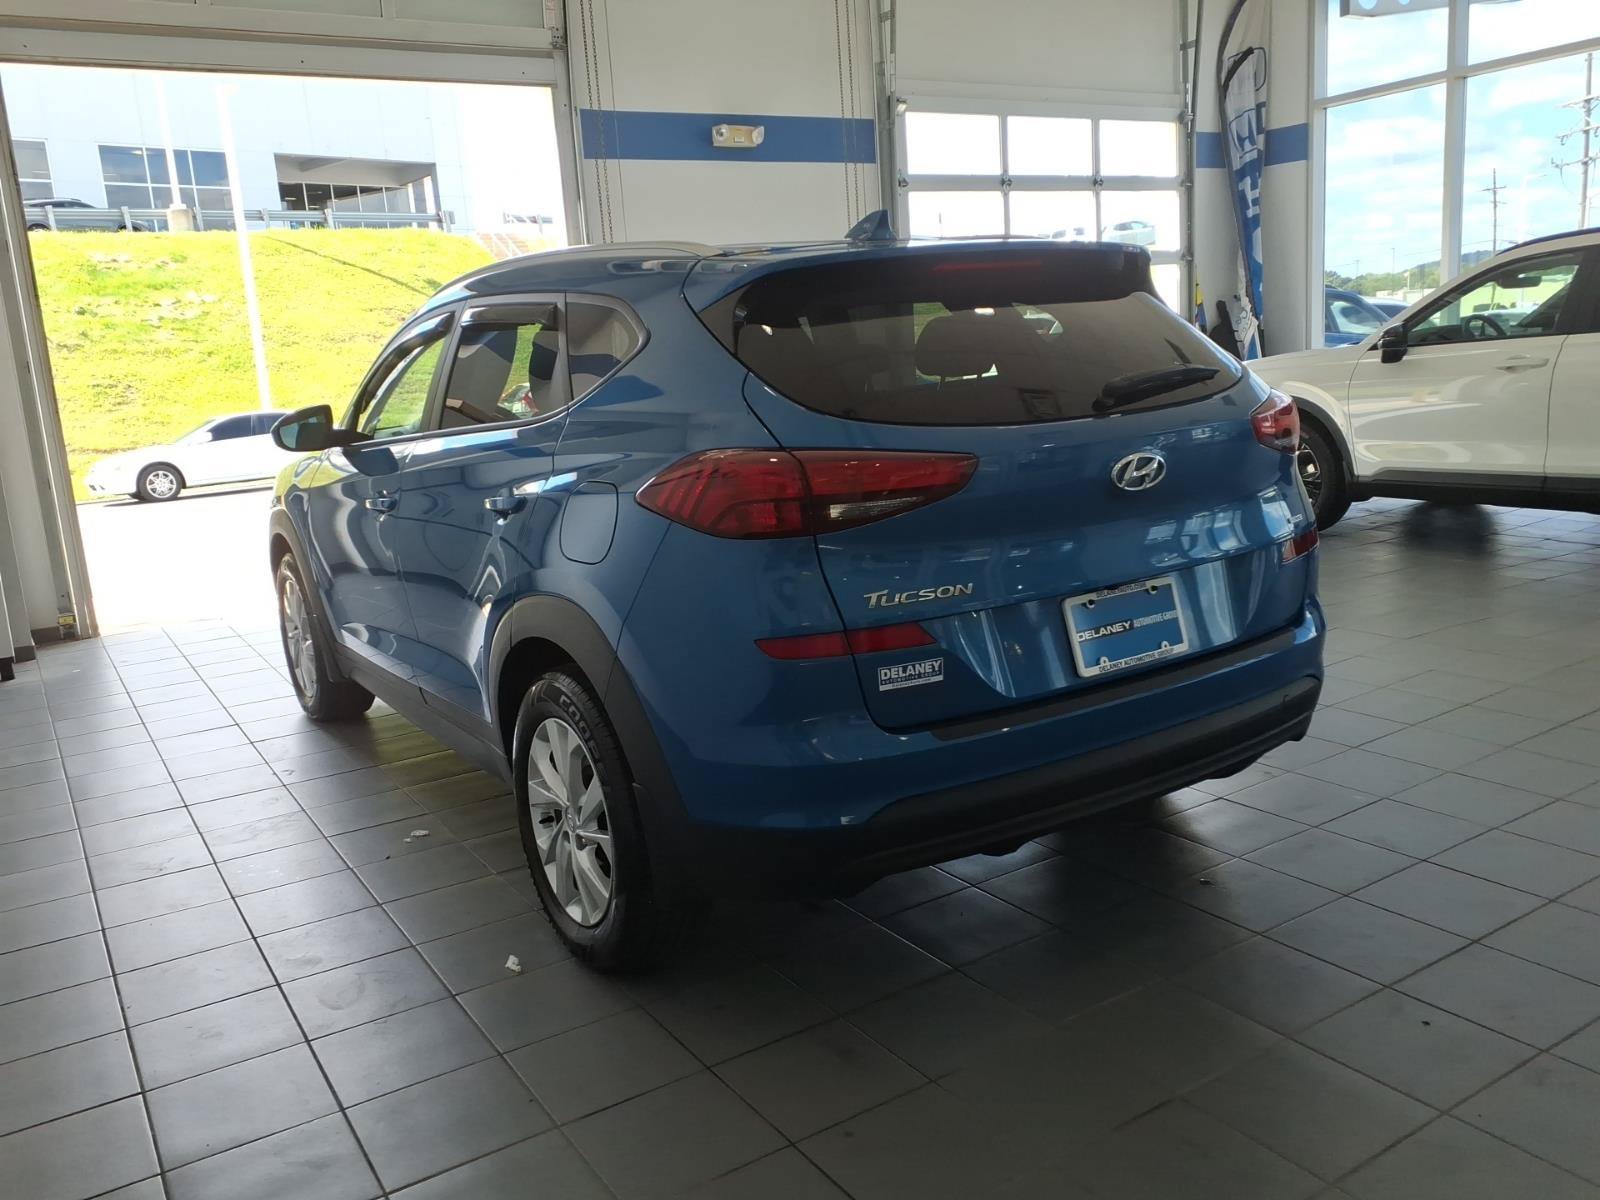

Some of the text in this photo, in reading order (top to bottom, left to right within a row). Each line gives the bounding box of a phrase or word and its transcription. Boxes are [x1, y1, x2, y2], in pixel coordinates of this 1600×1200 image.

[863, 582, 973, 608] TUCSON
[1077, 621, 1131, 642] DELANEY
[1133, 613, 1163, 628] AUTOMOTIVE
[880, 660, 941, 681] DELANEY
[1098, 660, 1123, 673] DELANEY
[1123, 651, 1157, 666] AUTOMOTIVE
